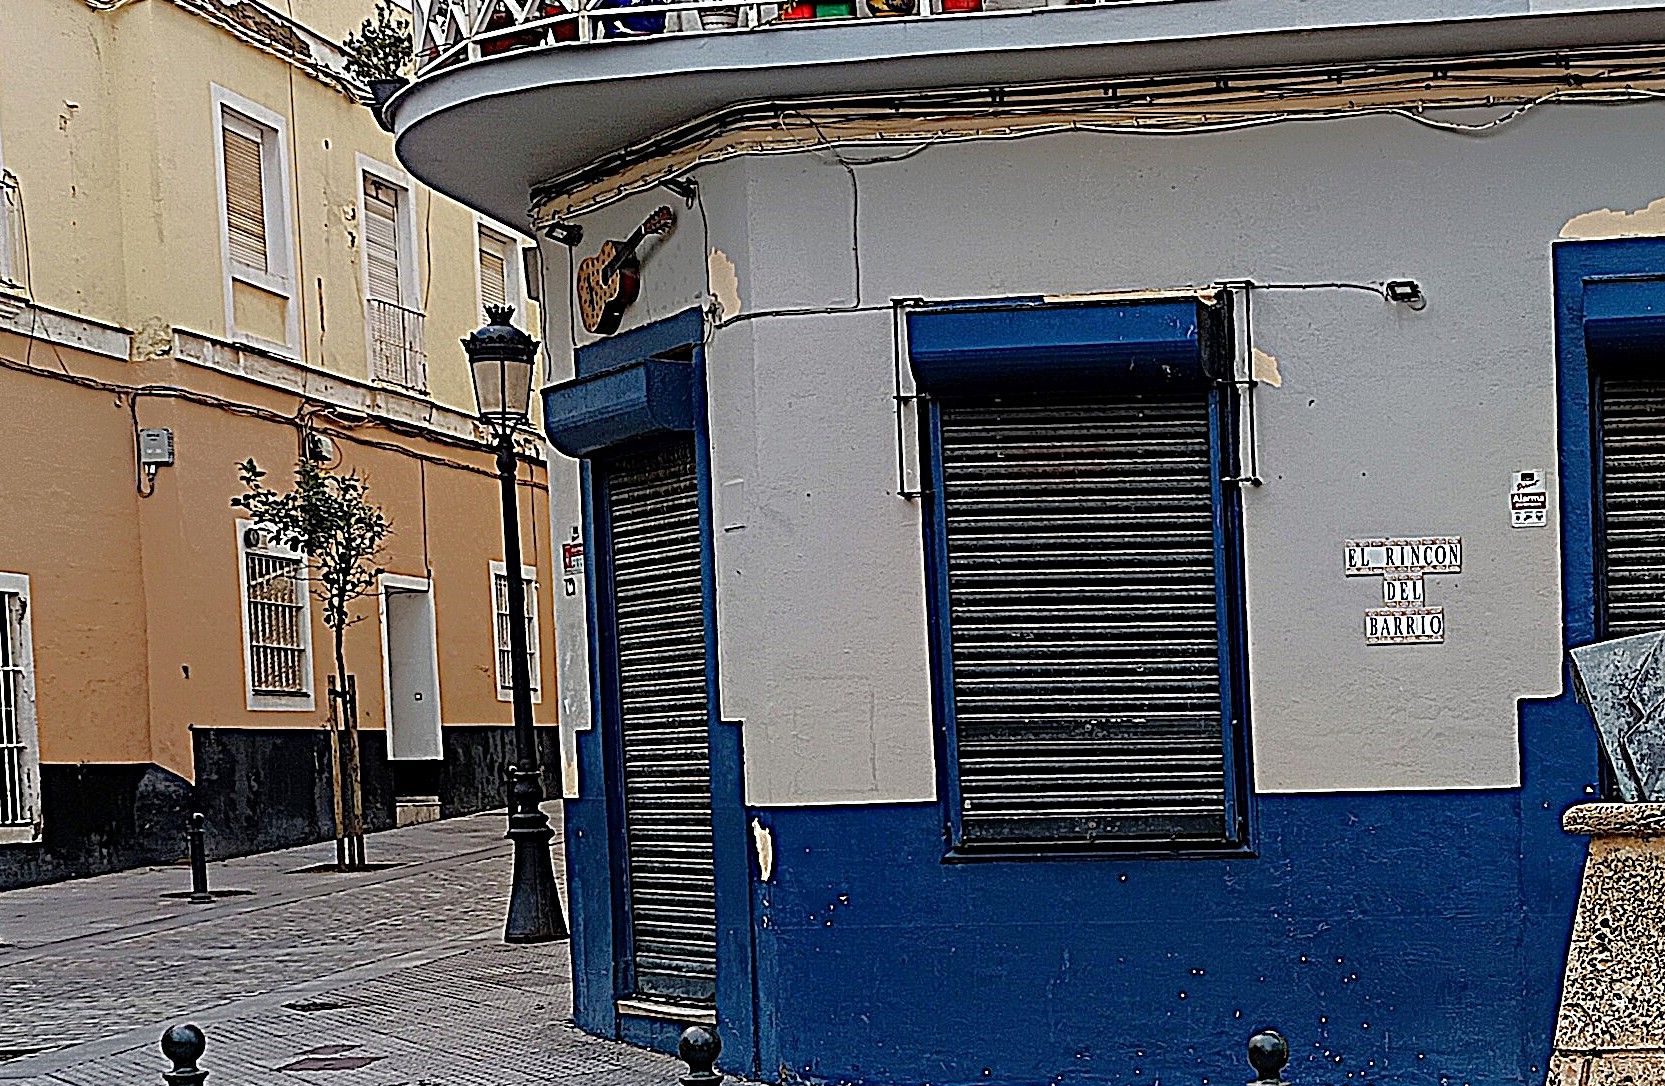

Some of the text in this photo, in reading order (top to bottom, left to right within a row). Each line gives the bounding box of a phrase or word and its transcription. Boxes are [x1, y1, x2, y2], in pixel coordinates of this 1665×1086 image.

[1513, 494, 1545, 503] Alarma
[1348, 544, 1459, 568] EL RINCON
[1386, 581, 1421, 601] DEL
[1369, 615, 1442, 636] BARRIO
